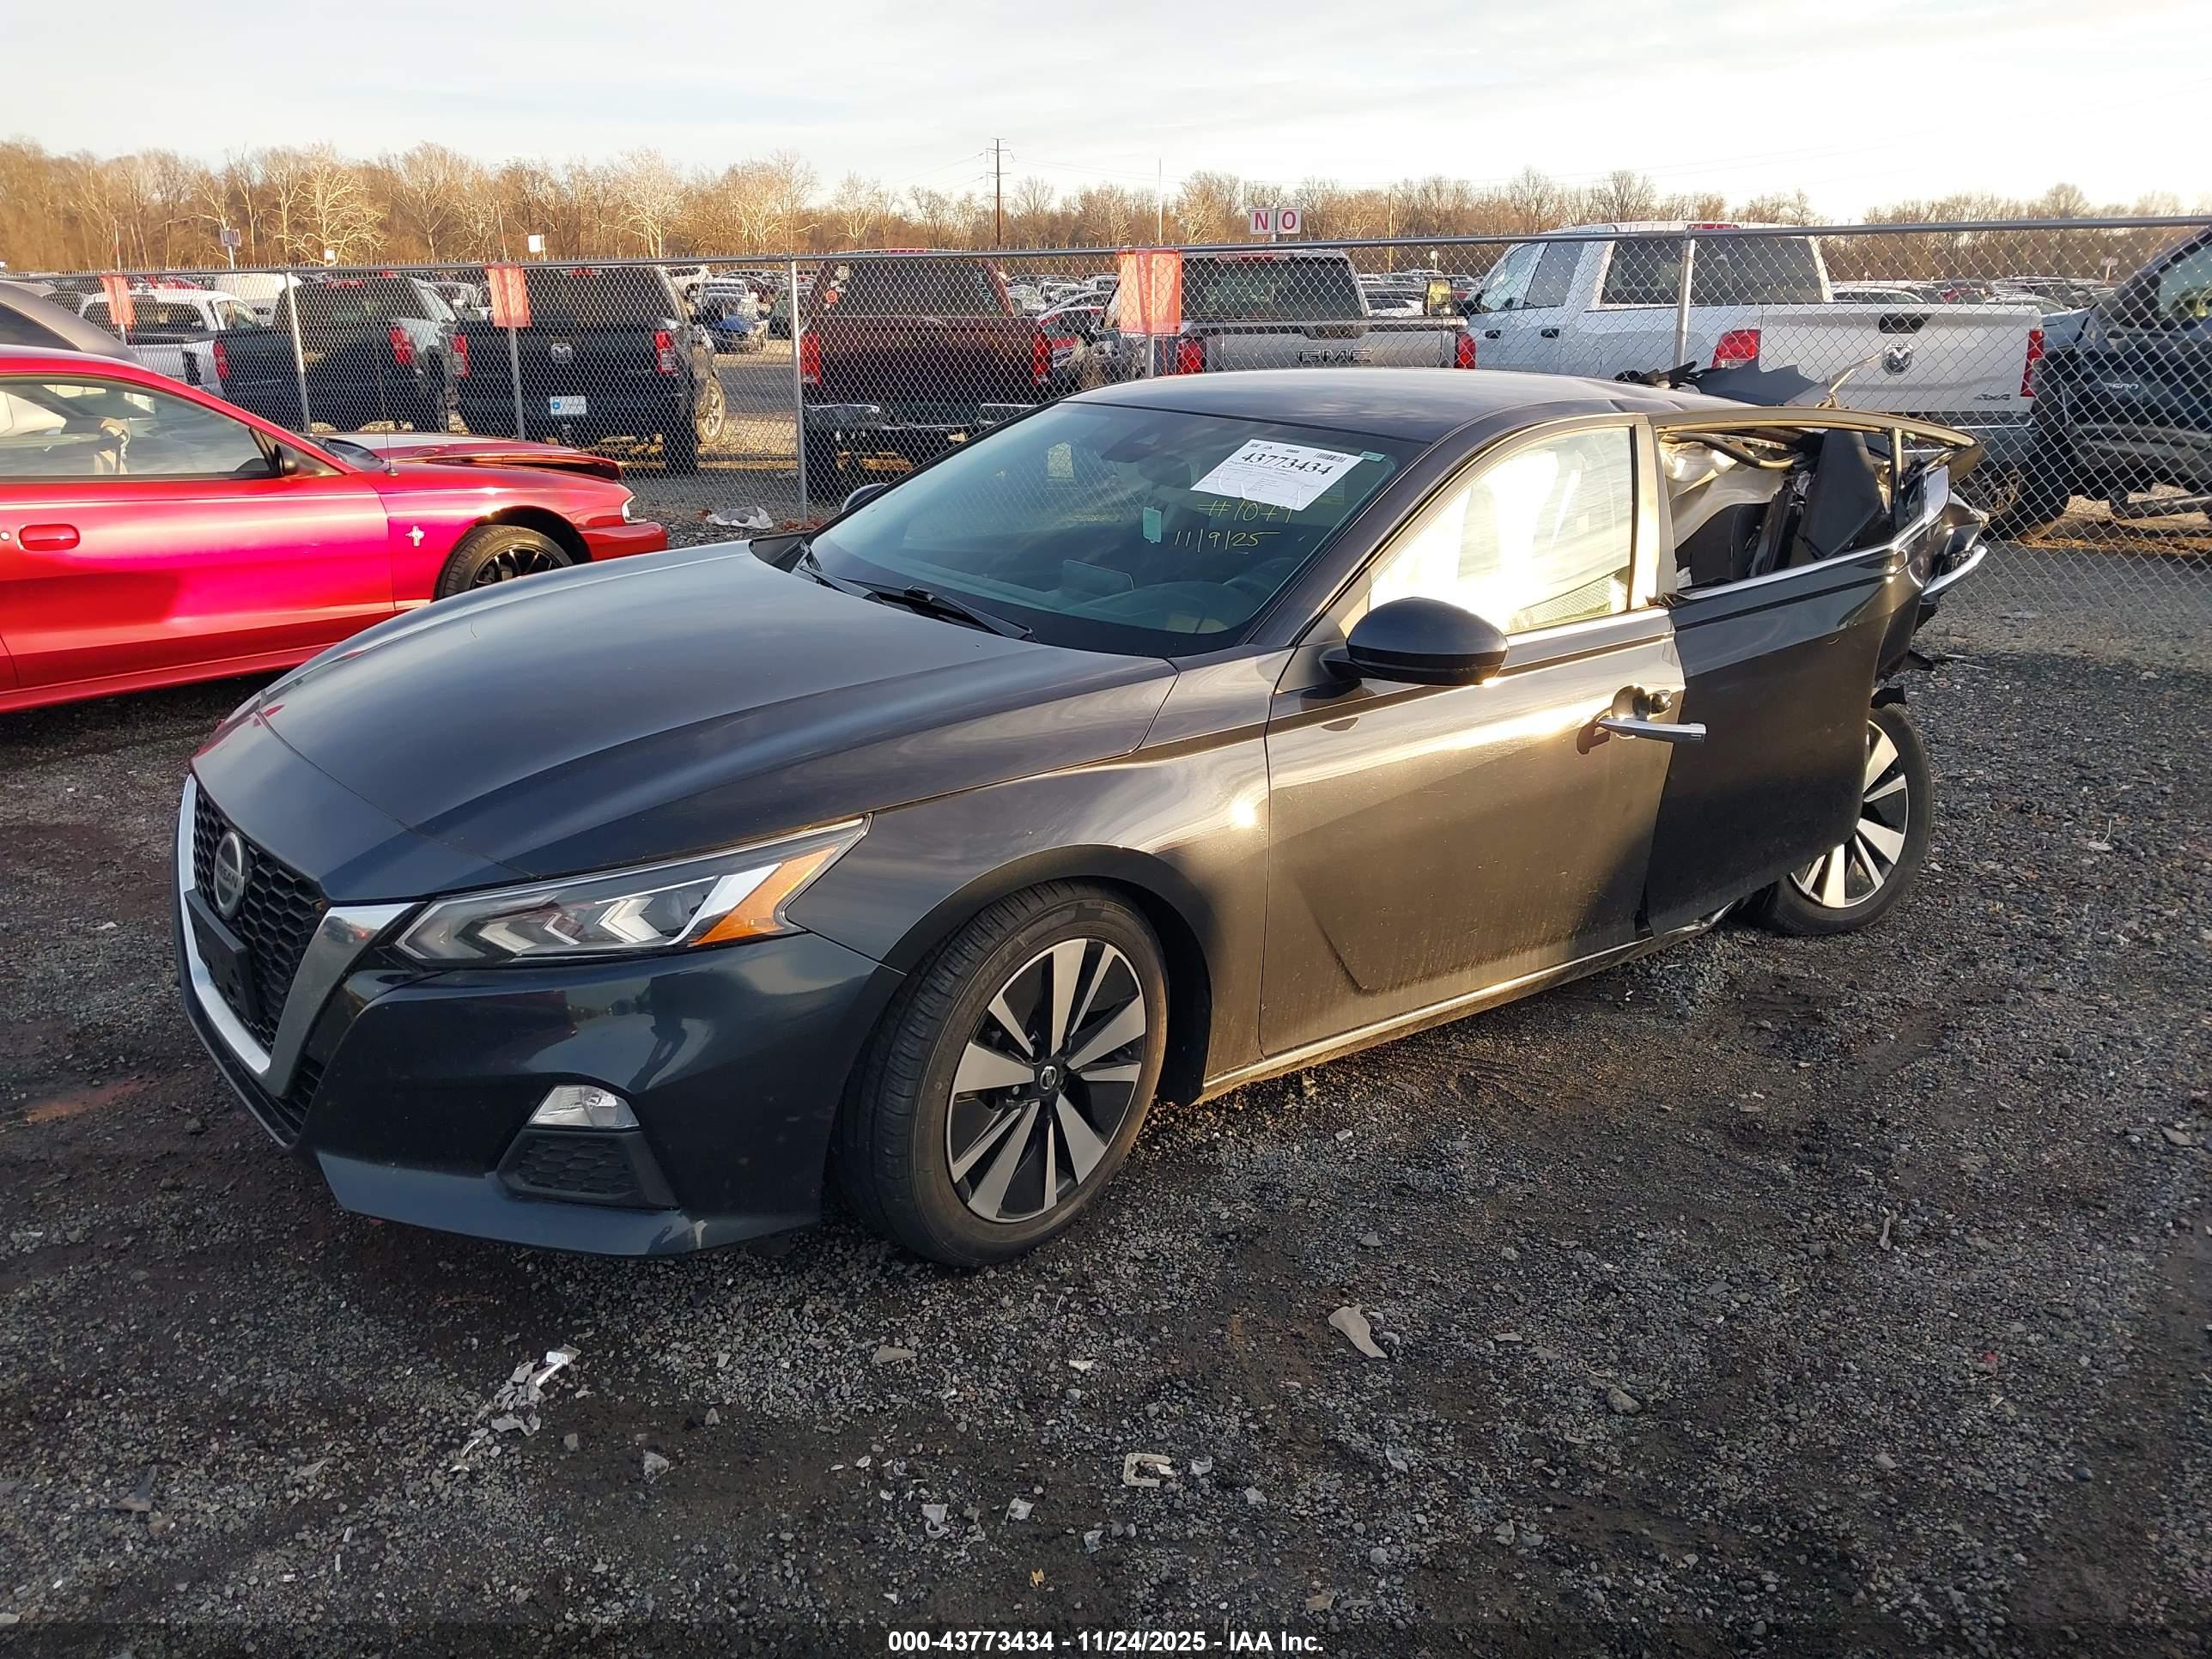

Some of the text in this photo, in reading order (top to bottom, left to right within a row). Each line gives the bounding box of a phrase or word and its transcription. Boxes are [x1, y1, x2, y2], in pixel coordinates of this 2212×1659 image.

[1298, 349, 1371, 363] GMC
[1241, 452, 1334, 475] 43773434
[1175, 528, 1281, 553] 11/9/25
